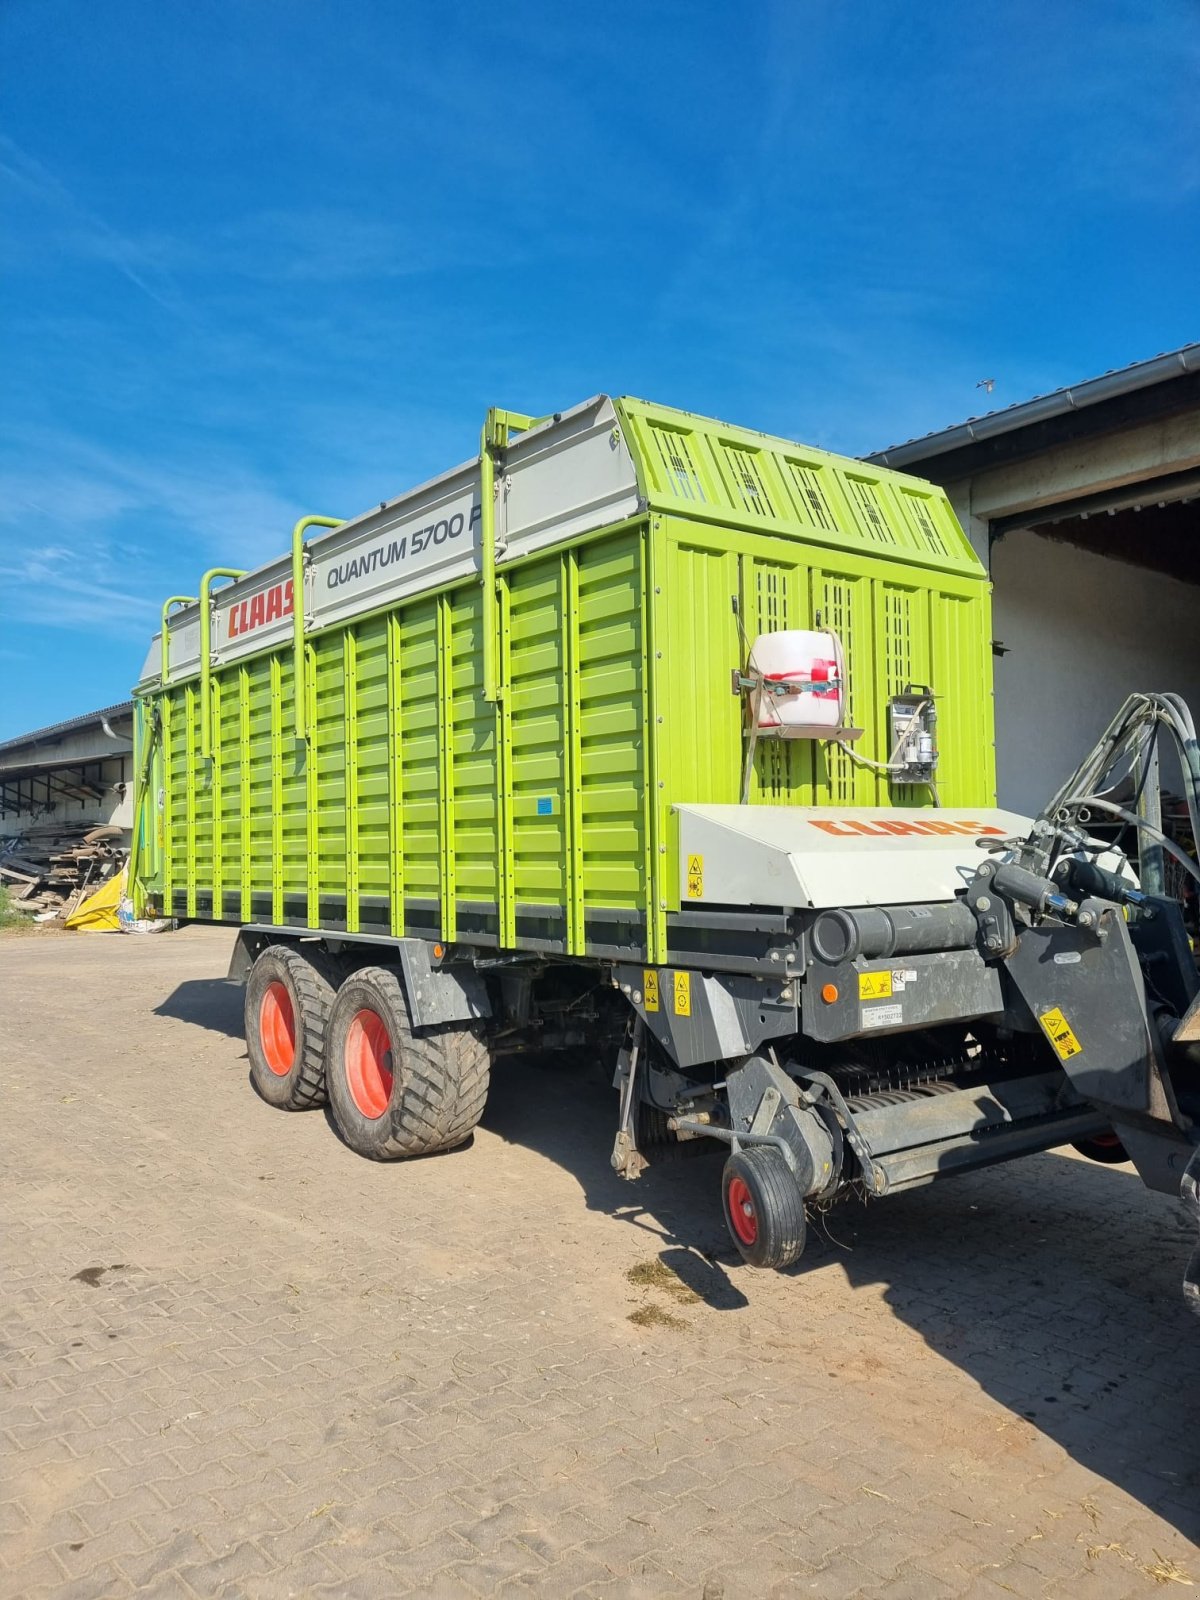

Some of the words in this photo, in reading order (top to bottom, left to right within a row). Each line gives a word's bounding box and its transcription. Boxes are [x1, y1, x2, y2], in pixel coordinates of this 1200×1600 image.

[327, 537, 407, 589] QUANTUM
[410, 512, 464, 556] 5700
[228, 579, 293, 638] CLAAS
[807, 820, 1008, 836] CLAAS
